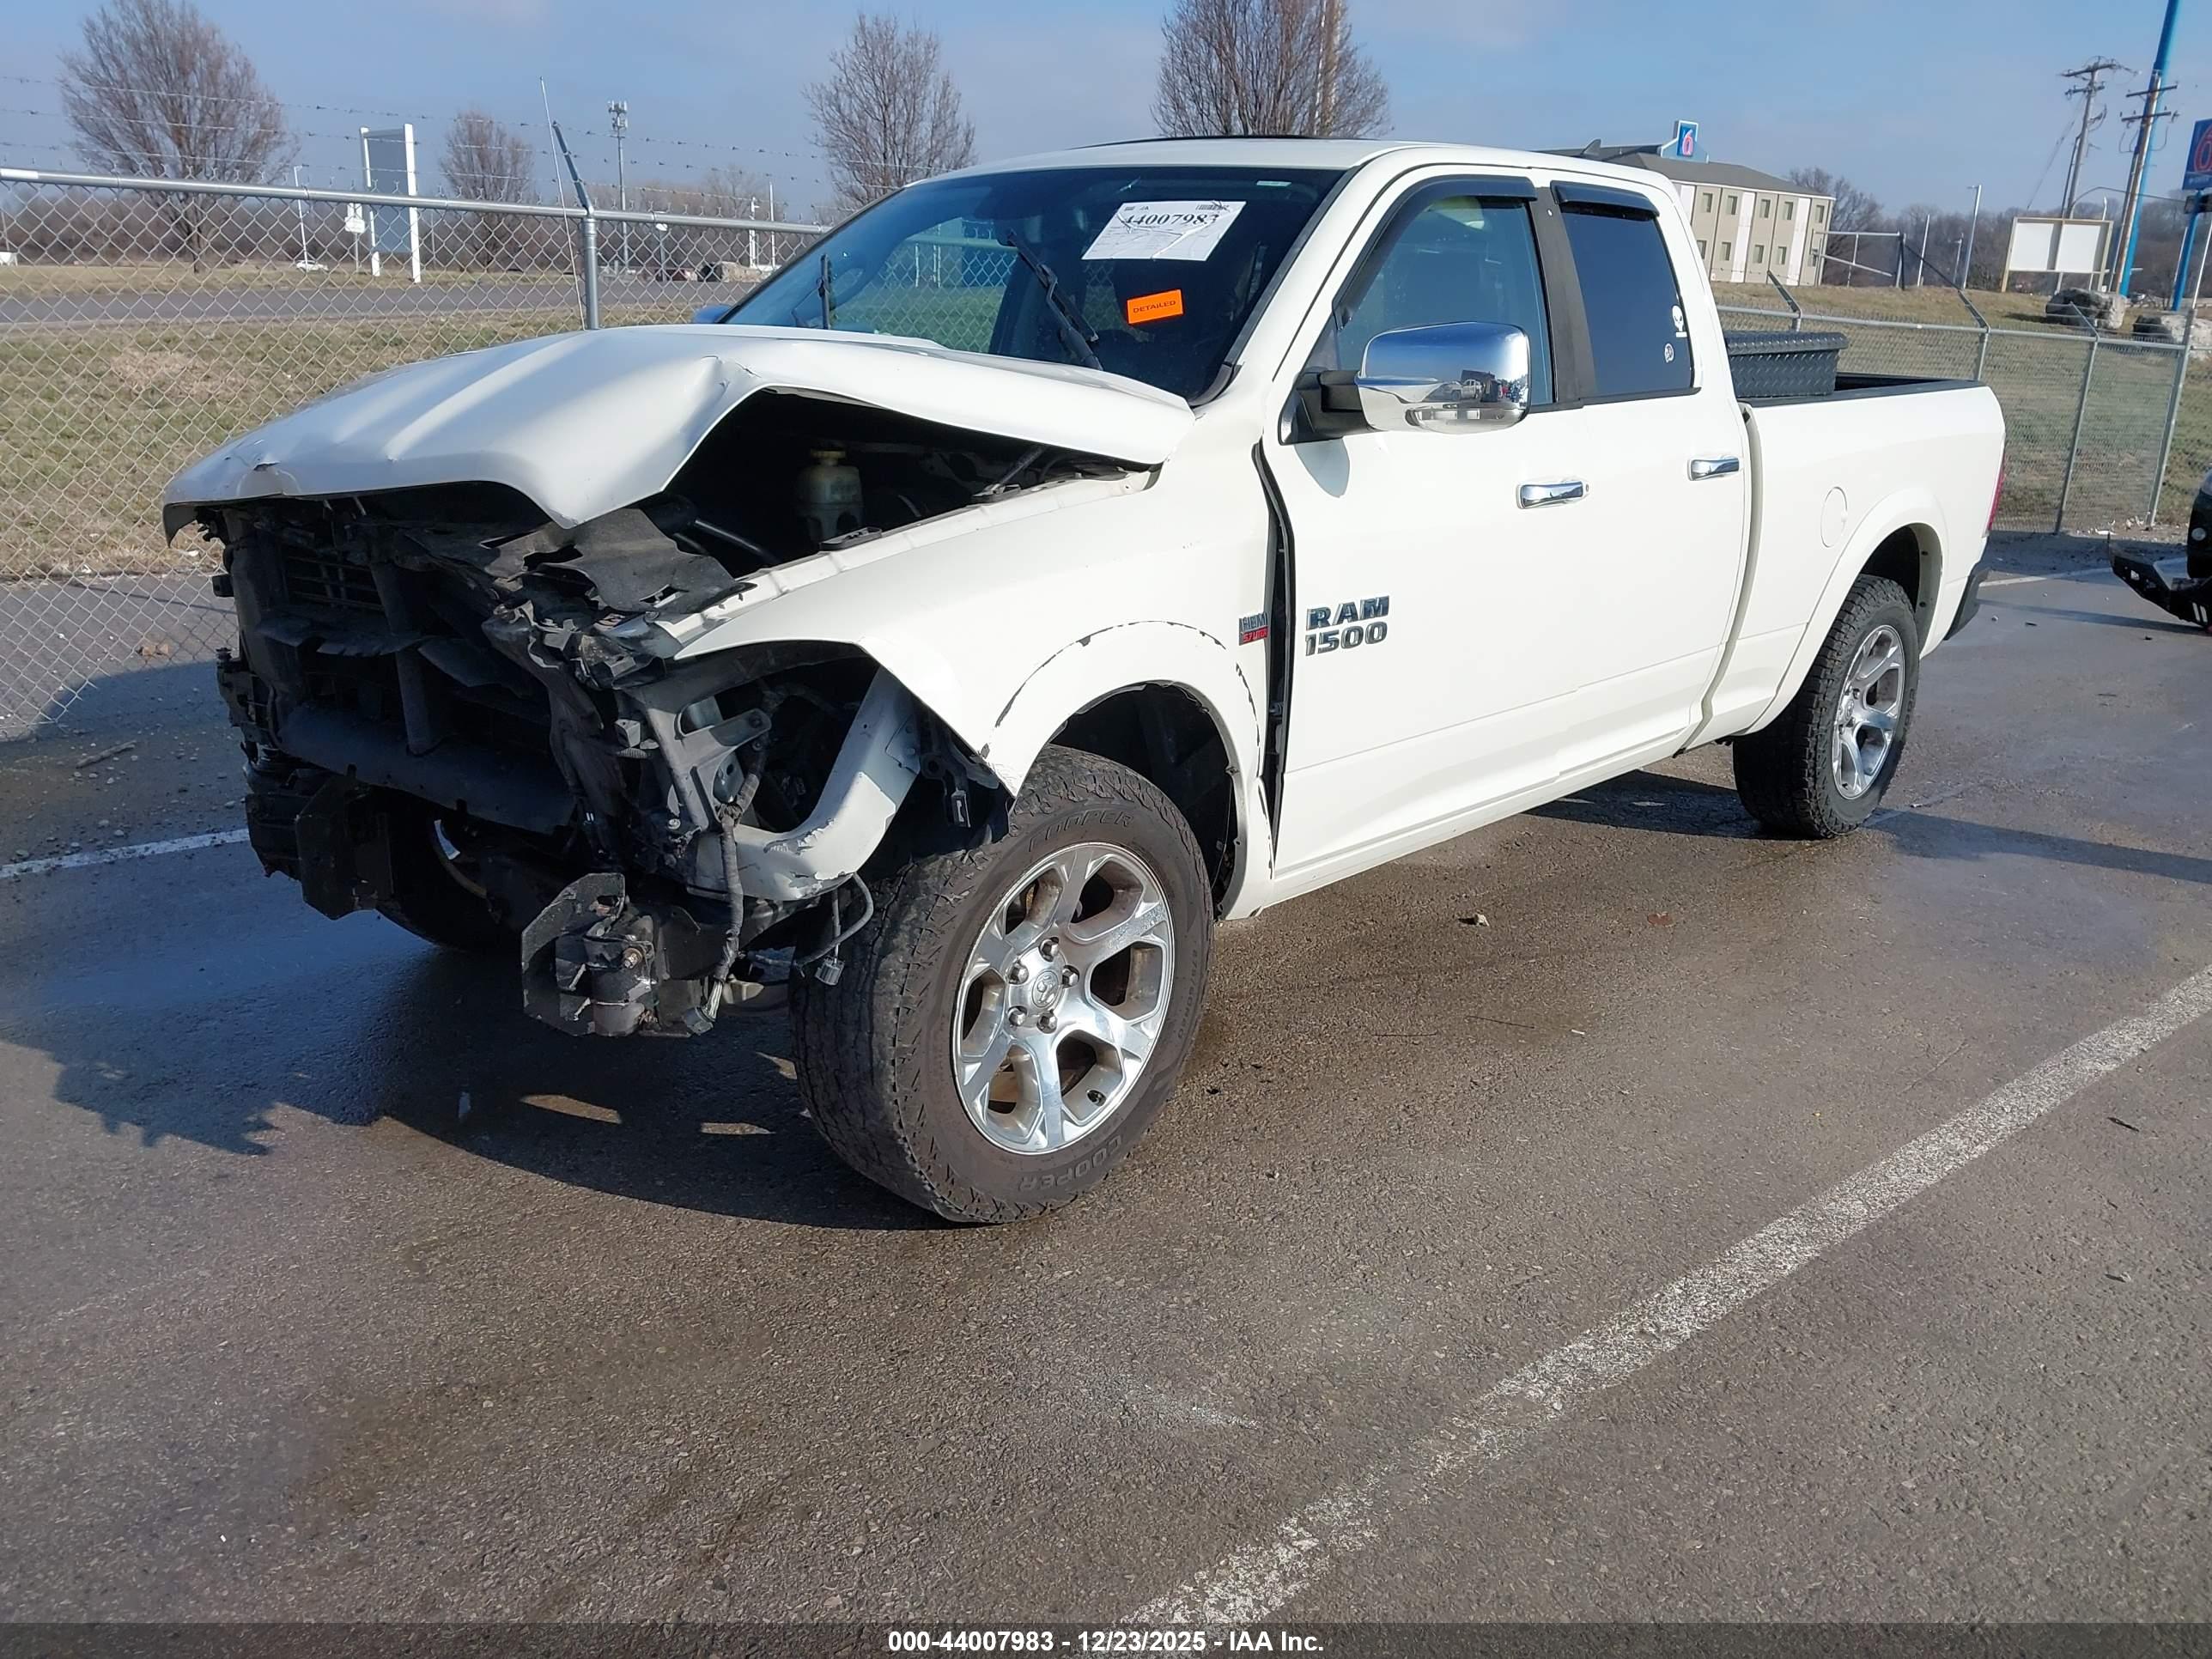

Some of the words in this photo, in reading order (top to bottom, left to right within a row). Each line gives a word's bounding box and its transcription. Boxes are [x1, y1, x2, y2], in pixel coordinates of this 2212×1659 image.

[1681, 129, 1693, 155] 6
[1133, 300, 1176, 313] DETAILED
[1306, 596, 1389, 630] RAM
[1304, 621, 1389, 657] 1500
[1018, 1134, 1121, 1192] COOPER
